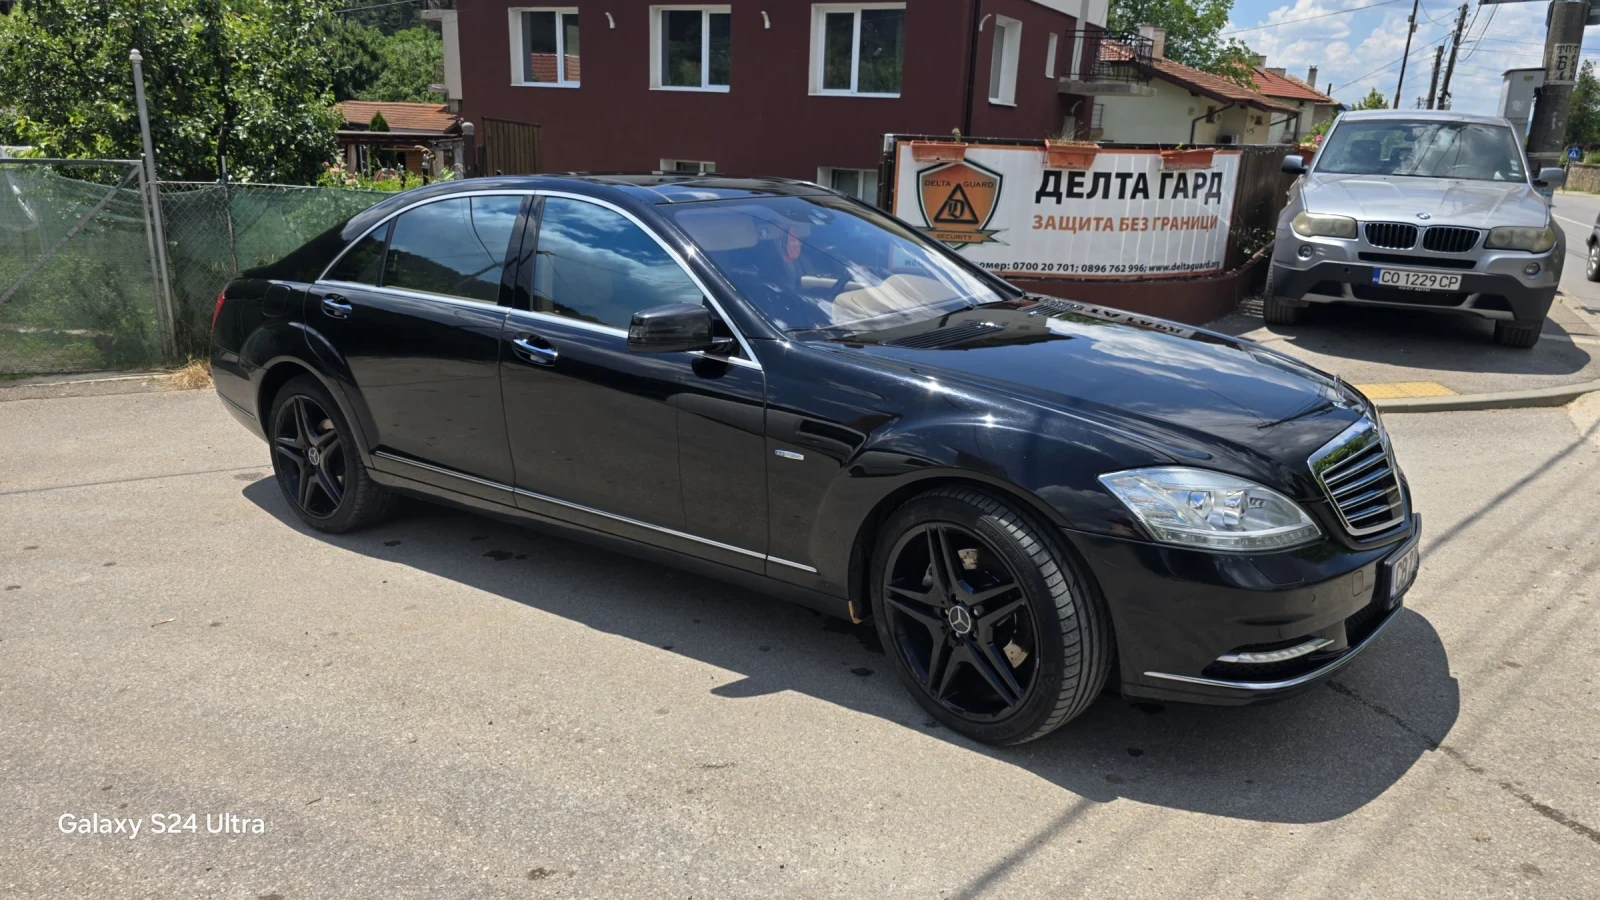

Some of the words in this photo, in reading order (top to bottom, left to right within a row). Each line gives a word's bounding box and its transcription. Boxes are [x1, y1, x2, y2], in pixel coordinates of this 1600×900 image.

[1034, 170, 1150, 205] ДЕЛТА
[1158, 172, 1223, 205] ГАРД
[1032, 215, 1114, 235] ЗАЩИТА
[1119, 217, 1149, 232] БЕЗ
[1152, 215, 1219, 233] ГРАНИЦИ
[971, 260, 1010, 271] омер:
[1012, 261, 1038, 271] 0700
[1041, 262, 1054, 271] 20
[1056, 263, 1079, 273] 701;
[1081, 264, 1107, 273] 0896
[1109, 264, 1126, 273] 762
[1128, 264, 1147, 273] 996;
[1148, 261, 1220, 272] www.deltaguard.org
[1381, 271, 1400, 284] CO
[1405, 273, 1437, 287] 1229
[1439, 276, 1459, 288] CP
